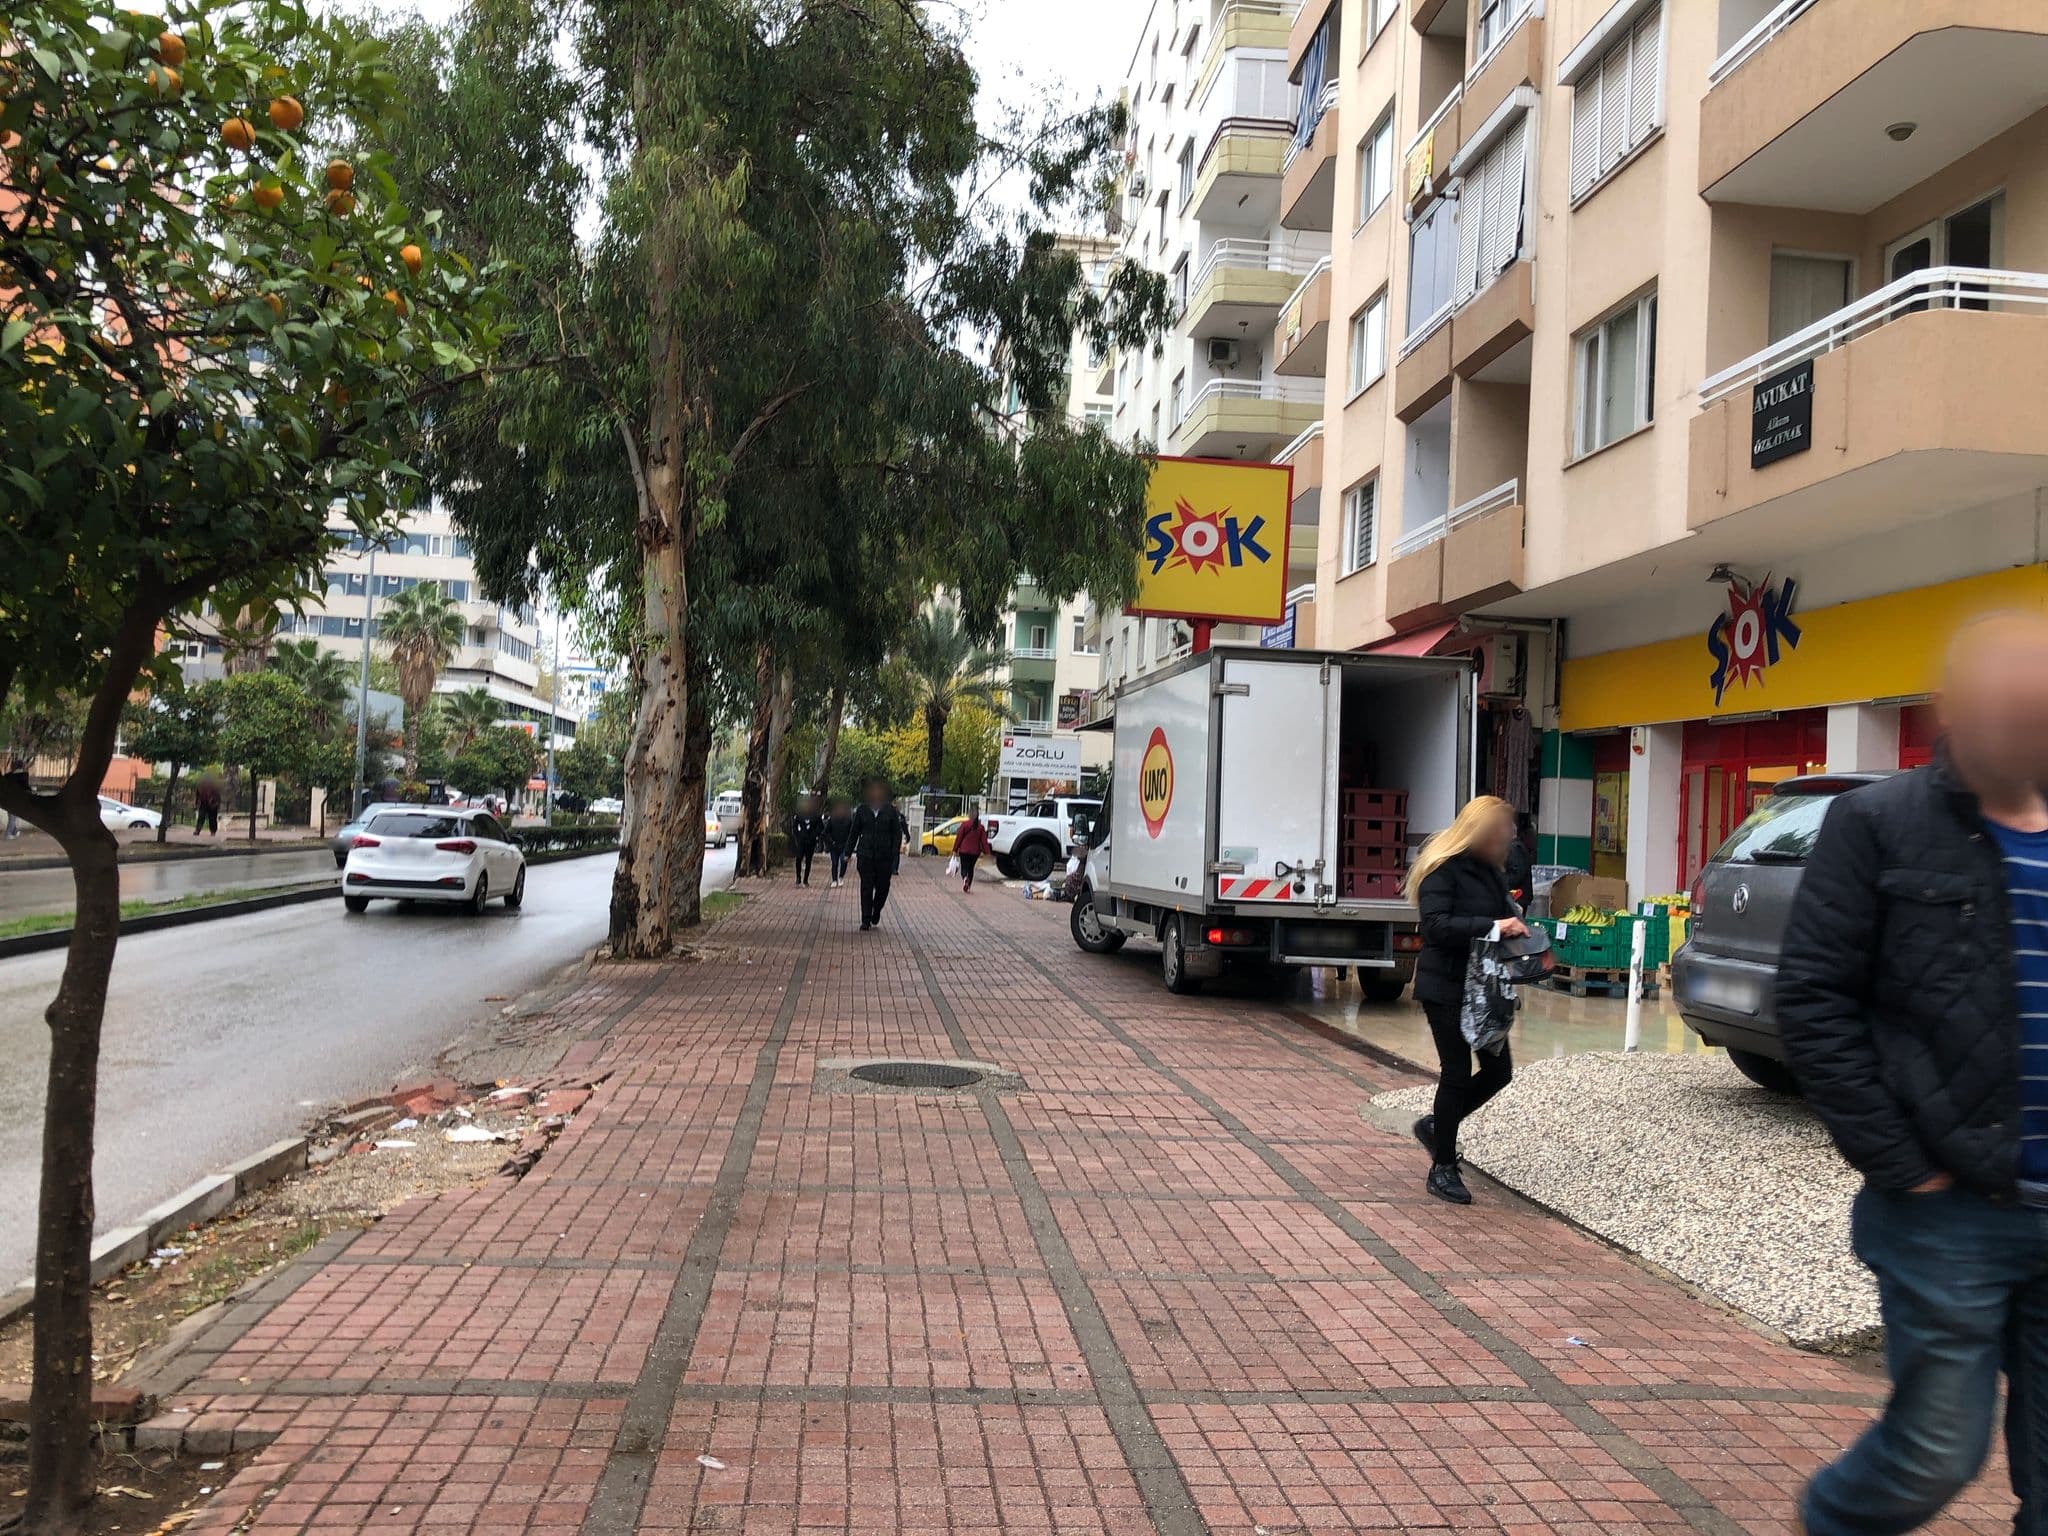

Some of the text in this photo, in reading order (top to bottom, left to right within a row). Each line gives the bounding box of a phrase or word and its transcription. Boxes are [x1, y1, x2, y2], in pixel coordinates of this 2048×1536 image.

[1752, 372, 1808, 415] AVUKAT
[1146, 512, 1271, 576] ŞOK
[1708, 577, 1802, 707] ŞOK
[1016, 748, 1065, 760] ZORLU
[1144, 767, 1168, 802] UNO
